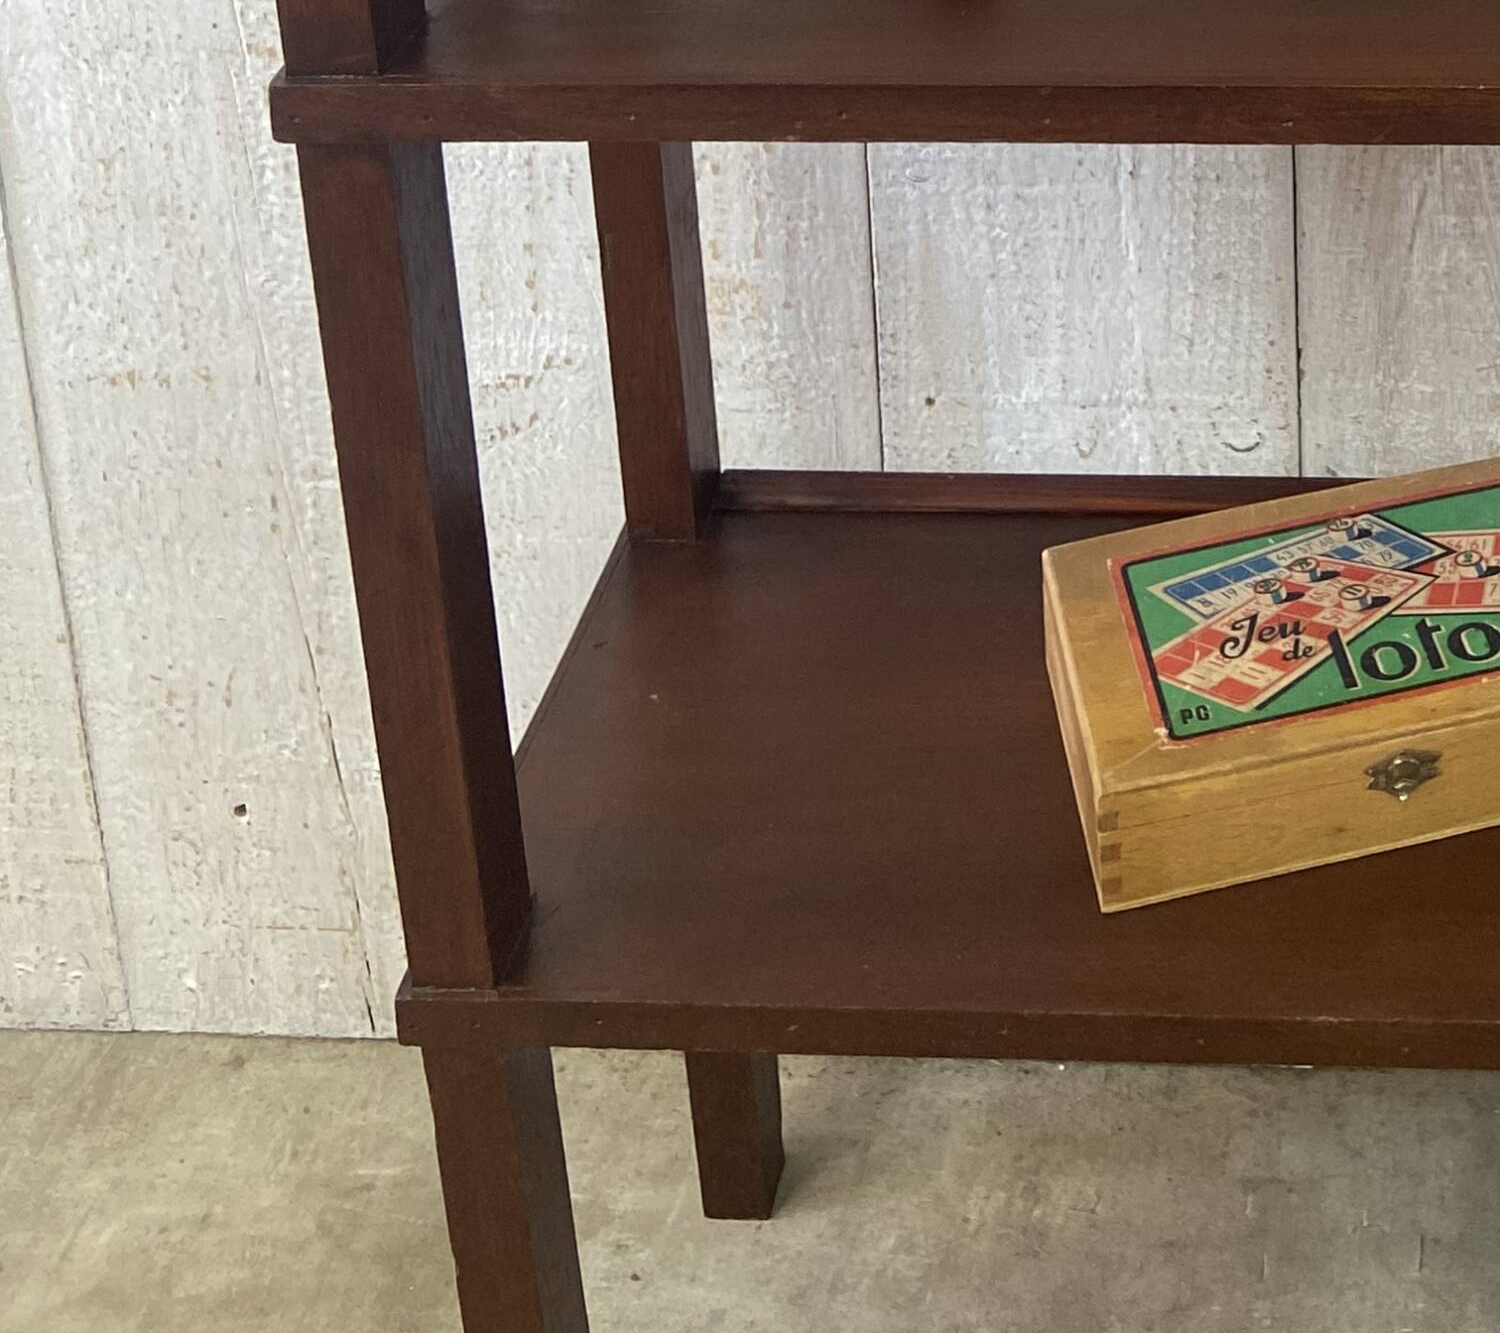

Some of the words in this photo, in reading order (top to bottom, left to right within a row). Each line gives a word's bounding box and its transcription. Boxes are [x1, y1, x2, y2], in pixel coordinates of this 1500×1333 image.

[1221, 588, 1238, 600] 19
[1219, 612, 1307, 659] Jeu
[1282, 638, 1317, 661] de
[1179, 704, 1211, 725] PG
